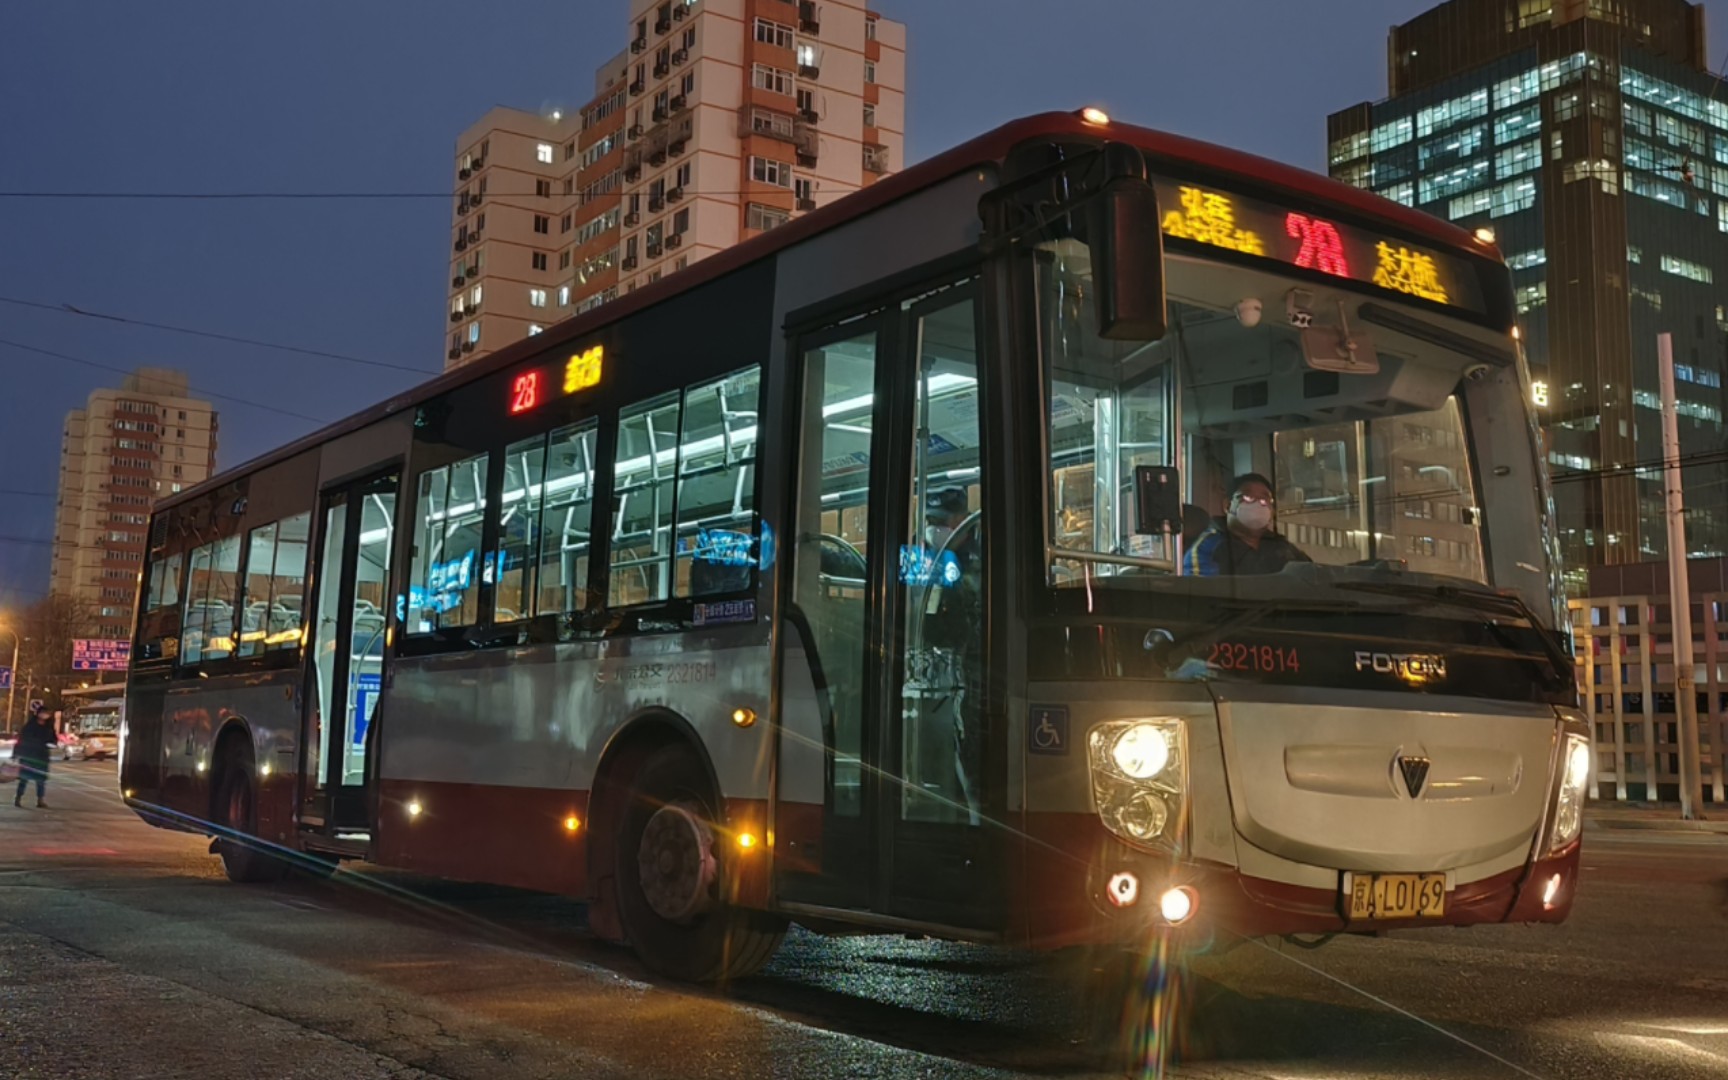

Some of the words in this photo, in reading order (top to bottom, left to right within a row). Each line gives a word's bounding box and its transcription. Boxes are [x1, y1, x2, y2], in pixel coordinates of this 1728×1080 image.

[511, 372, 536, 412] 28
[1207, 643, 1299, 672] 2321814
[1354, 650, 1447, 678] FOTON
